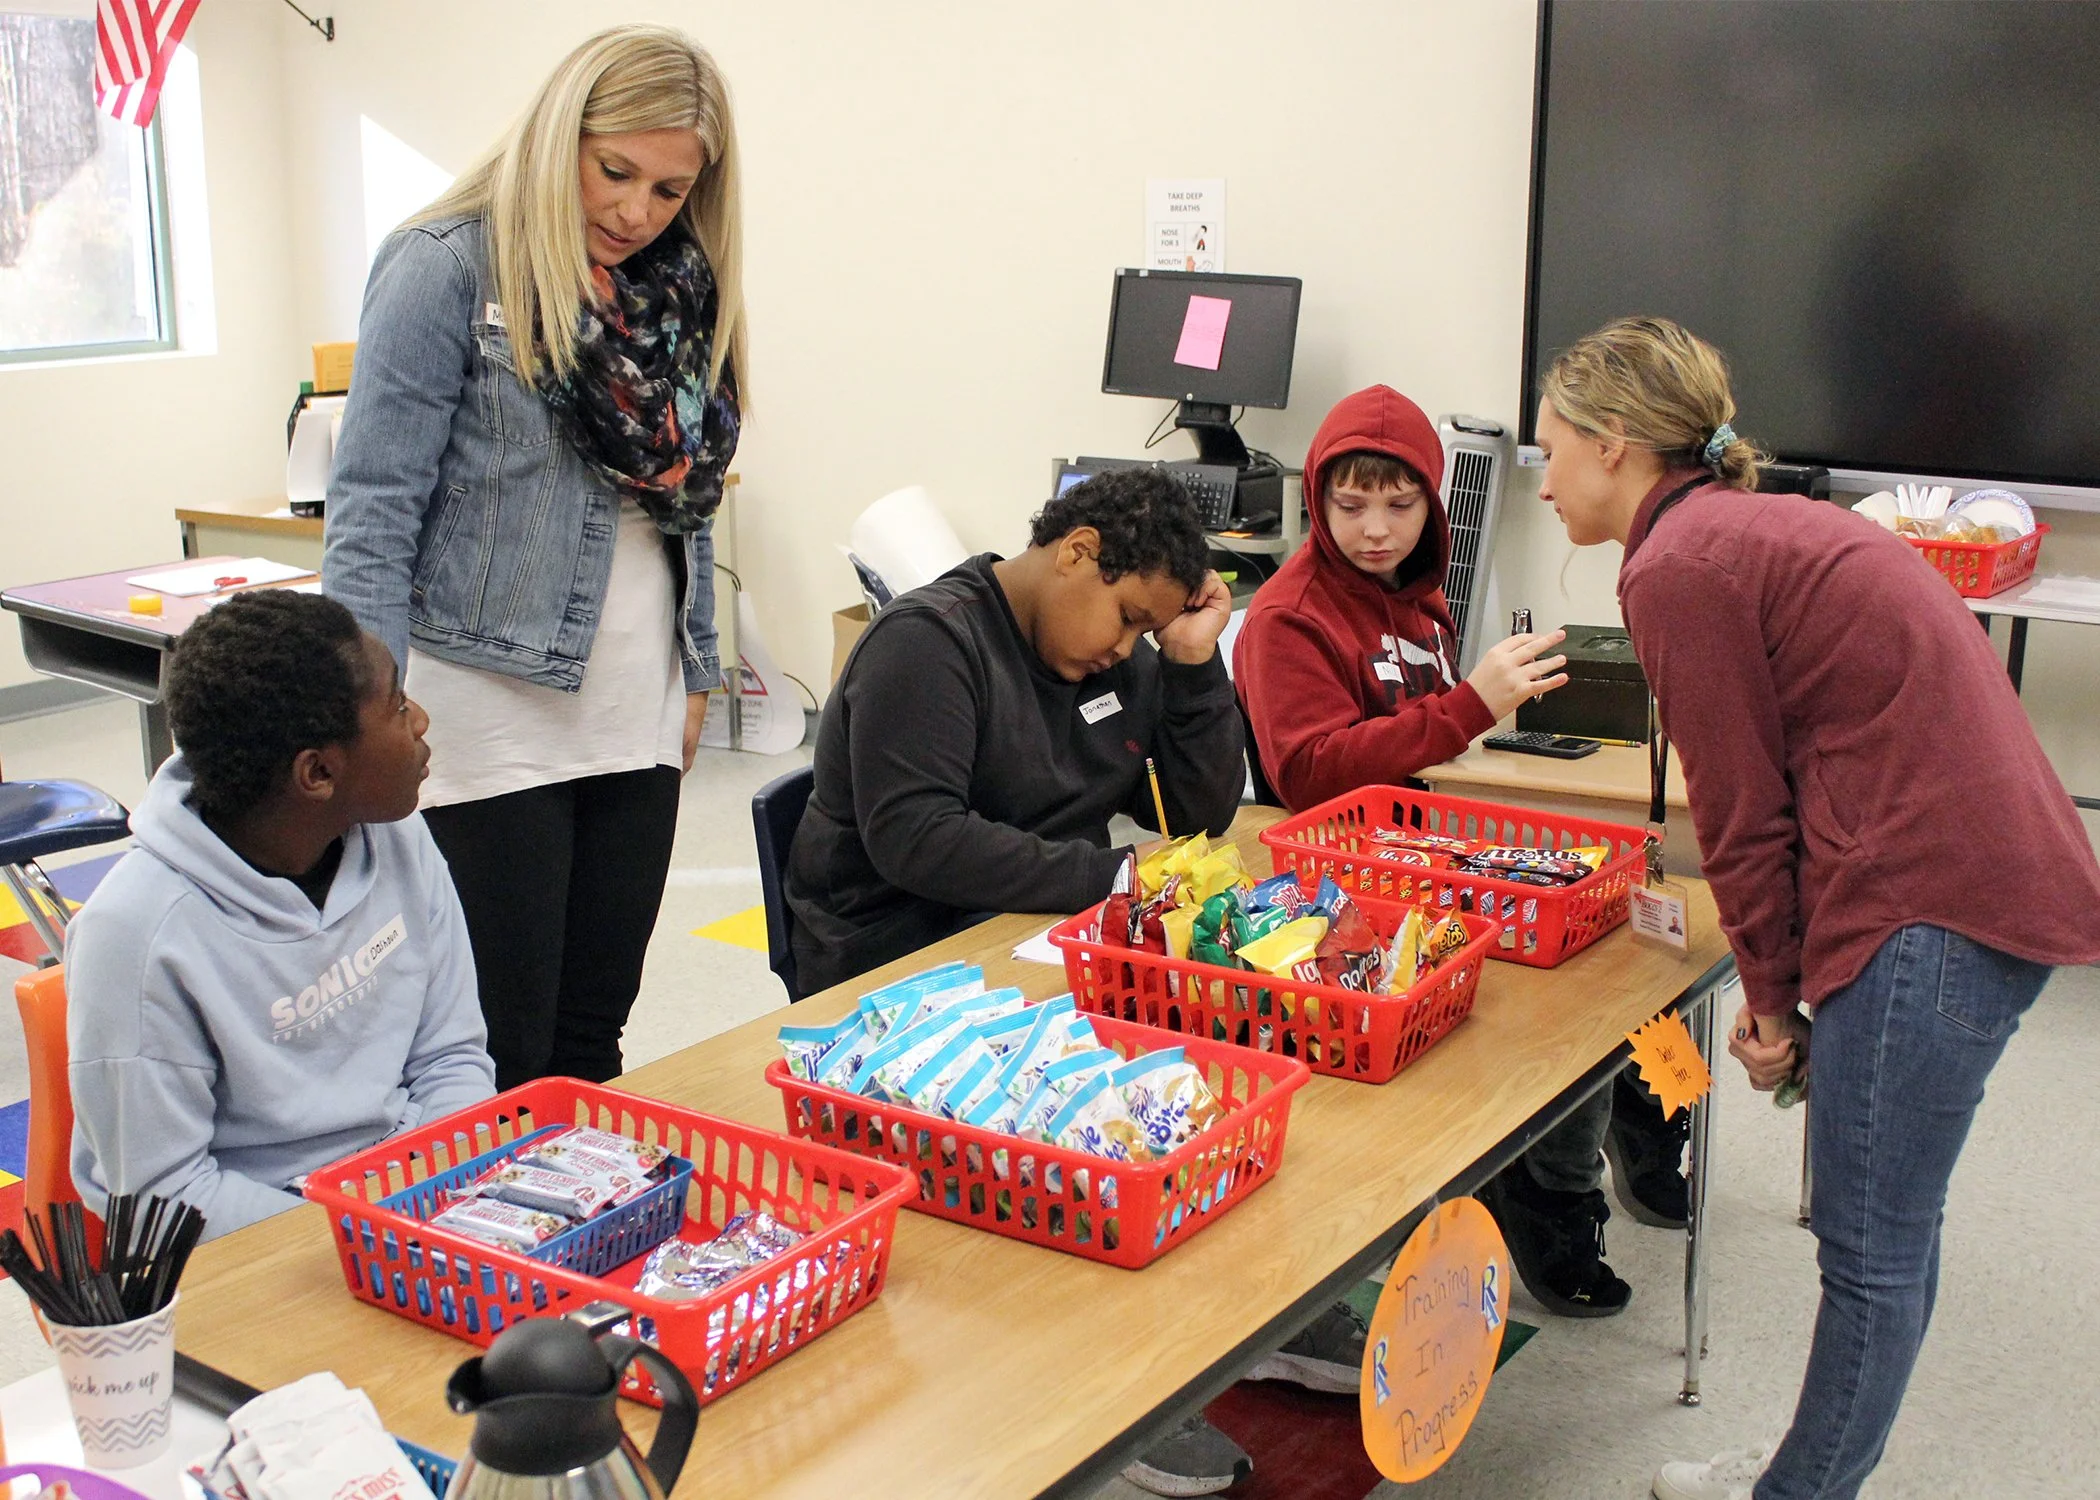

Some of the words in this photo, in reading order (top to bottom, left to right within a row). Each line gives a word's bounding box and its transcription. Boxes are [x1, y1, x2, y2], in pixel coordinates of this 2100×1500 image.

[1167, 192, 1185, 200] TAKE
[1186, 192, 1204, 200] DEEP
[1170, 204, 1201, 212] BREATHS
[1161, 228, 1179, 236] NOSE
[1161, 239, 1174, 247] FOR
[1158, 257, 1182, 266] MOUTH
[270, 949, 372, 1030] SONIC
[1395, 1265, 1470, 1326] Training
[1415, 1340, 1444, 1379] In
[104, 1380, 135, 1395] me
[138, 1371, 160, 1395] up
[1395, 1370, 1479, 1468] Progress
